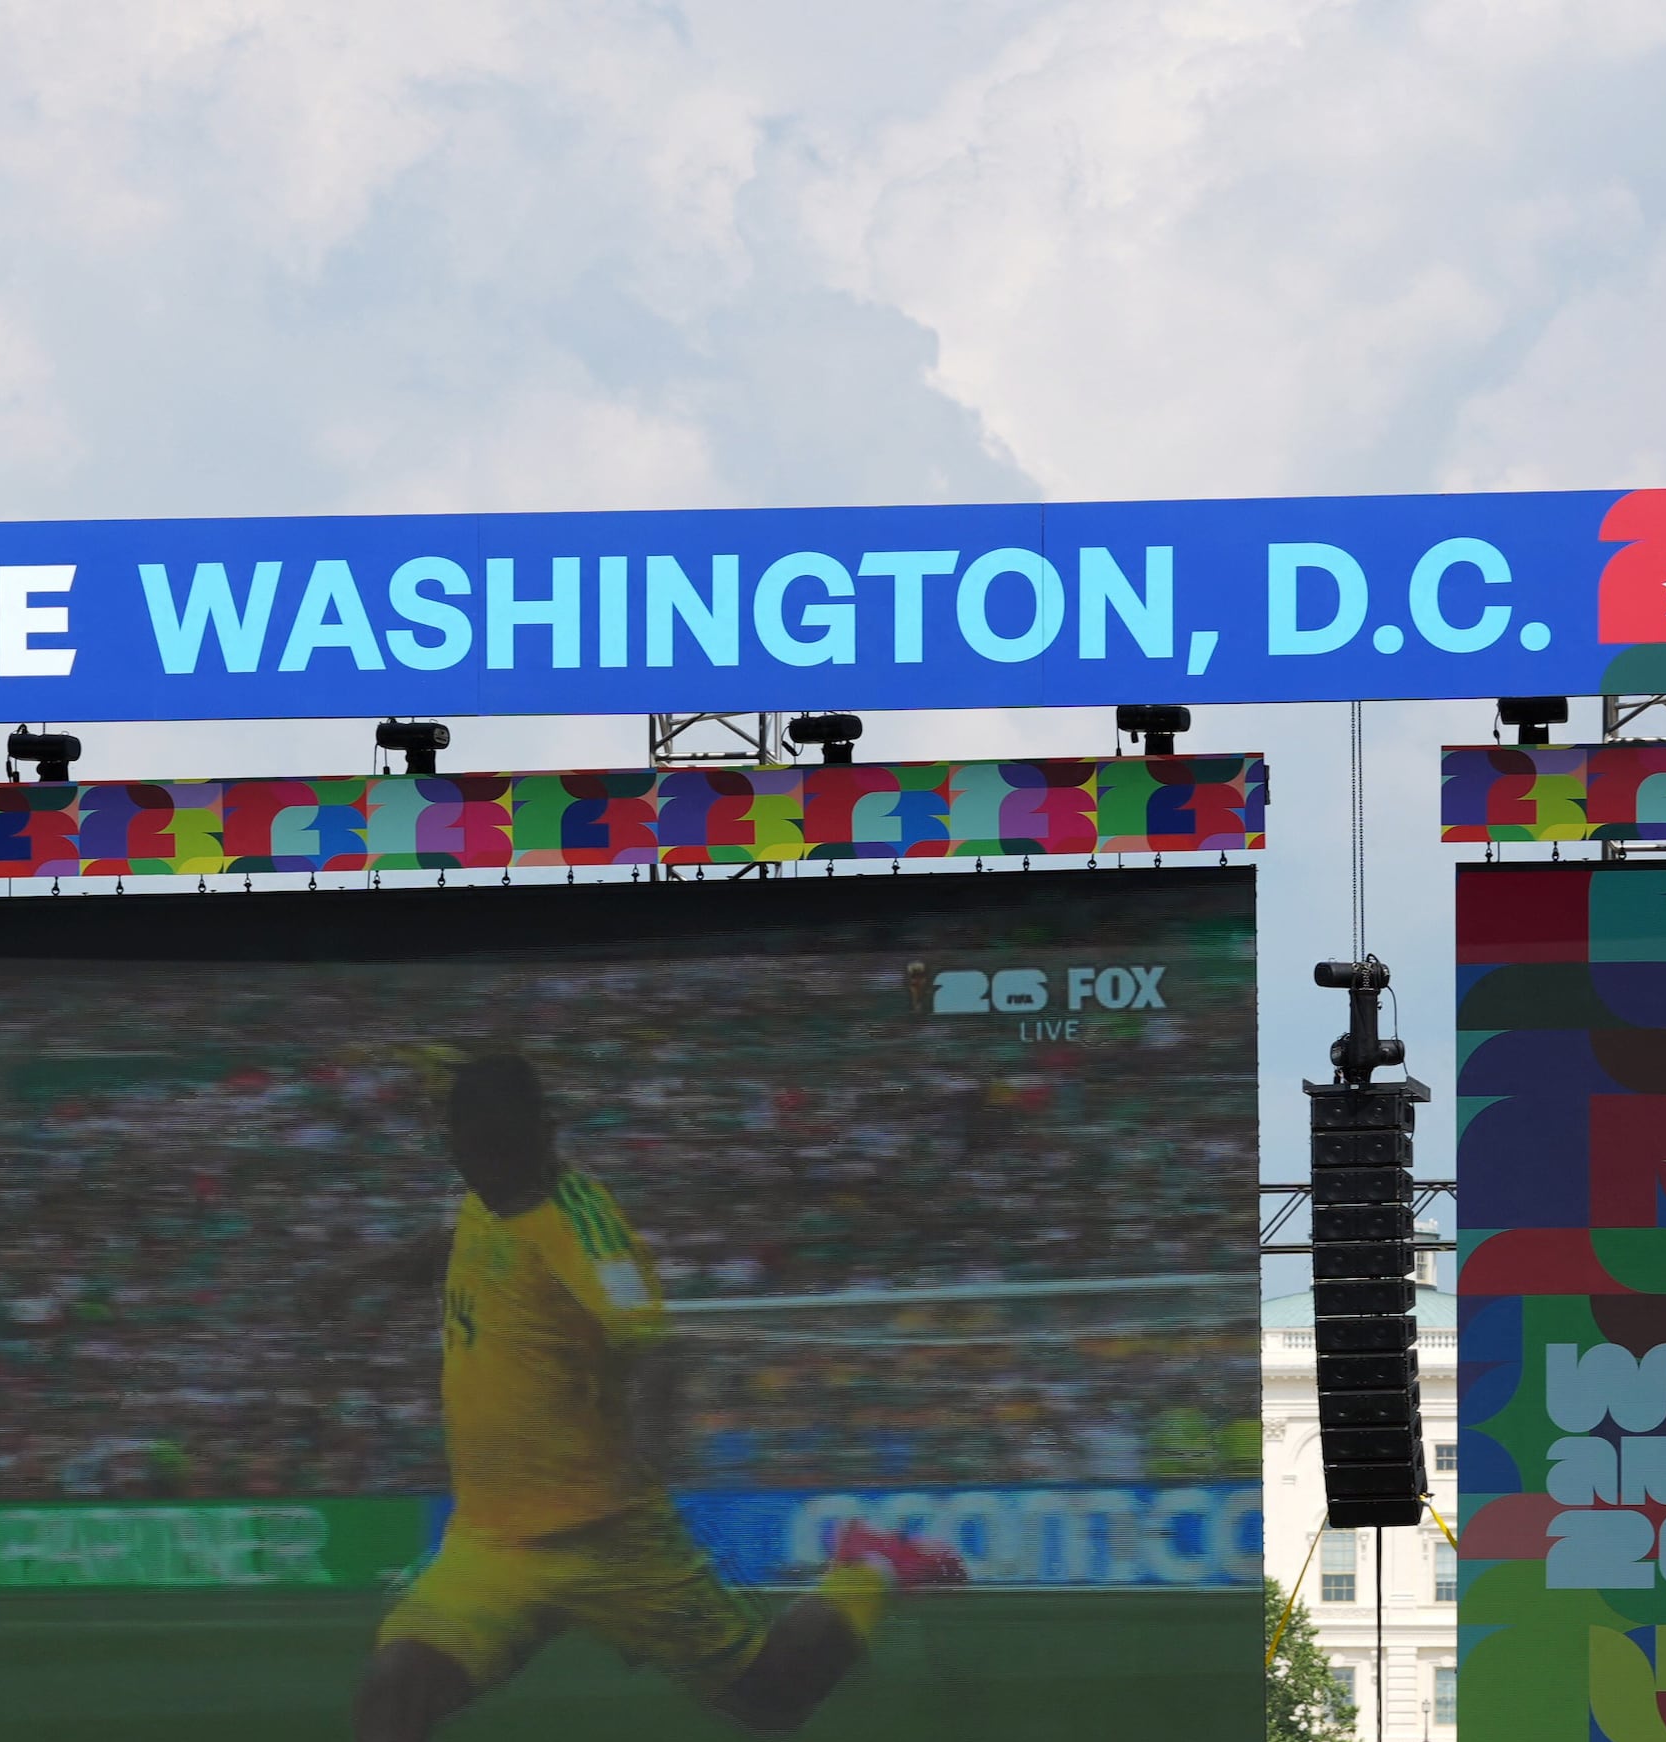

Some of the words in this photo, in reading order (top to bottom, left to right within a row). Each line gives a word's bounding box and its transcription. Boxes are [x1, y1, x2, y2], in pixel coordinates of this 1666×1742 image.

[139, 545, 1220, 676] WASHINGTON,
[1267, 537, 1552, 655] D.C.
[1068, 966, 1166, 1010] FOX
[1020, 1020, 1081, 1043] LIVE
